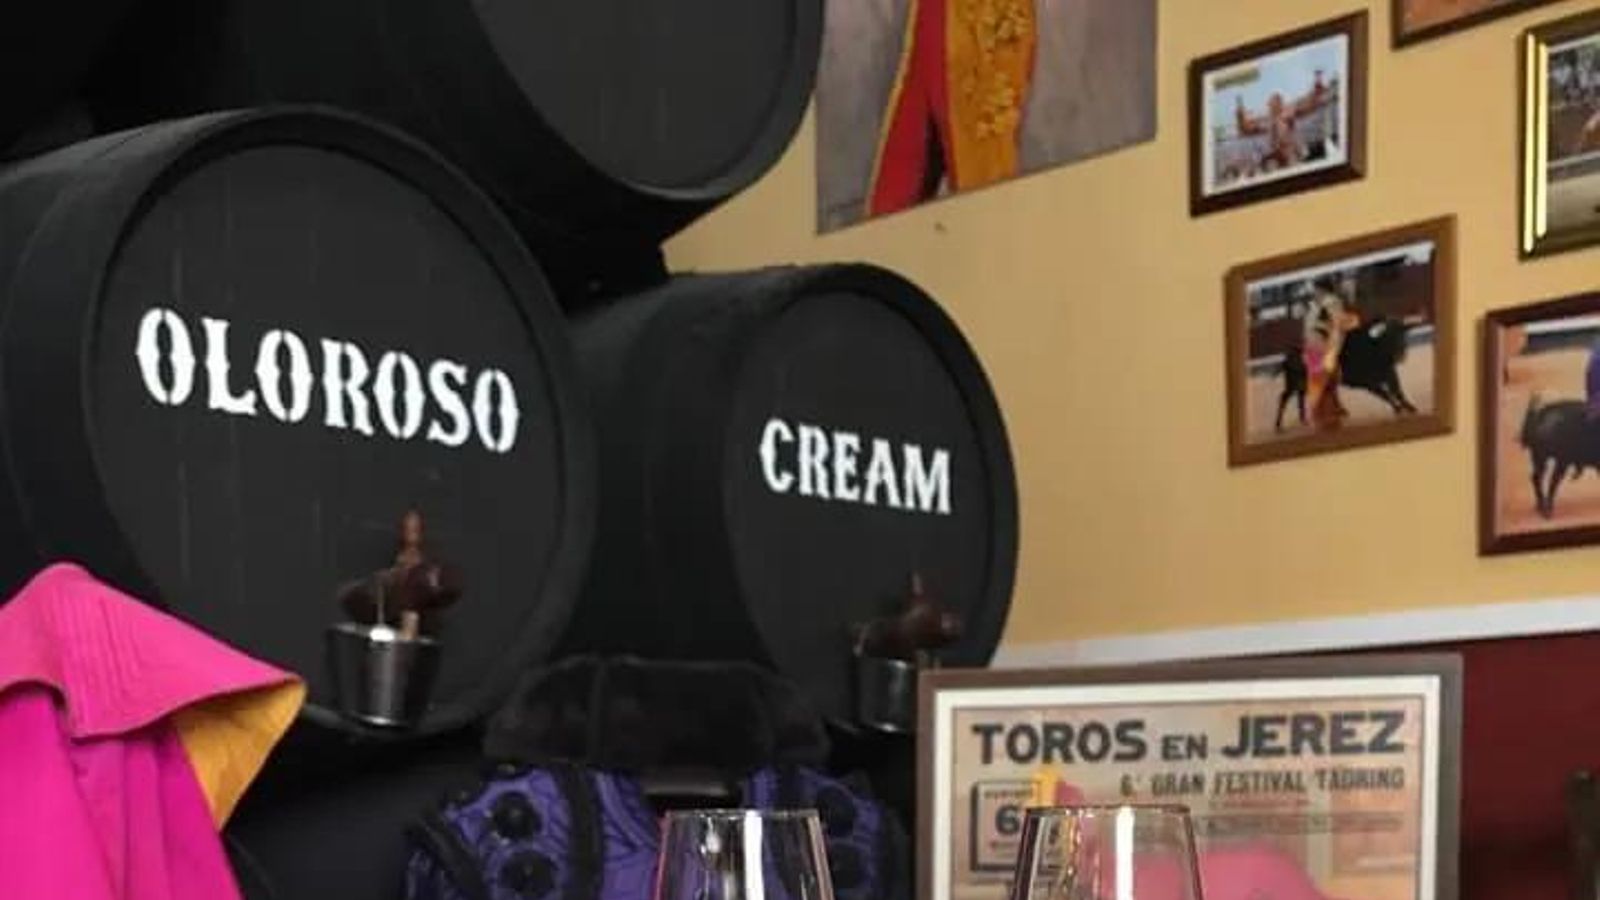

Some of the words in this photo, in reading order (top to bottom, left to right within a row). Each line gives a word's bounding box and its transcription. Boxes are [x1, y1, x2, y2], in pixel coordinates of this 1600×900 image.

[136, 308, 520, 453] OLOROSO
[759, 418, 951, 515] CREAM
[971, 720, 1148, 765] TOROS
[1161, 735, 1207, 761] EN
[1222, 711, 1405, 757] JEREZ
[1151, 773, 1204, 796] GRAN
[1213, 769, 1307, 795] FESTIVAL
[994, 804, 1021, 834] 6
